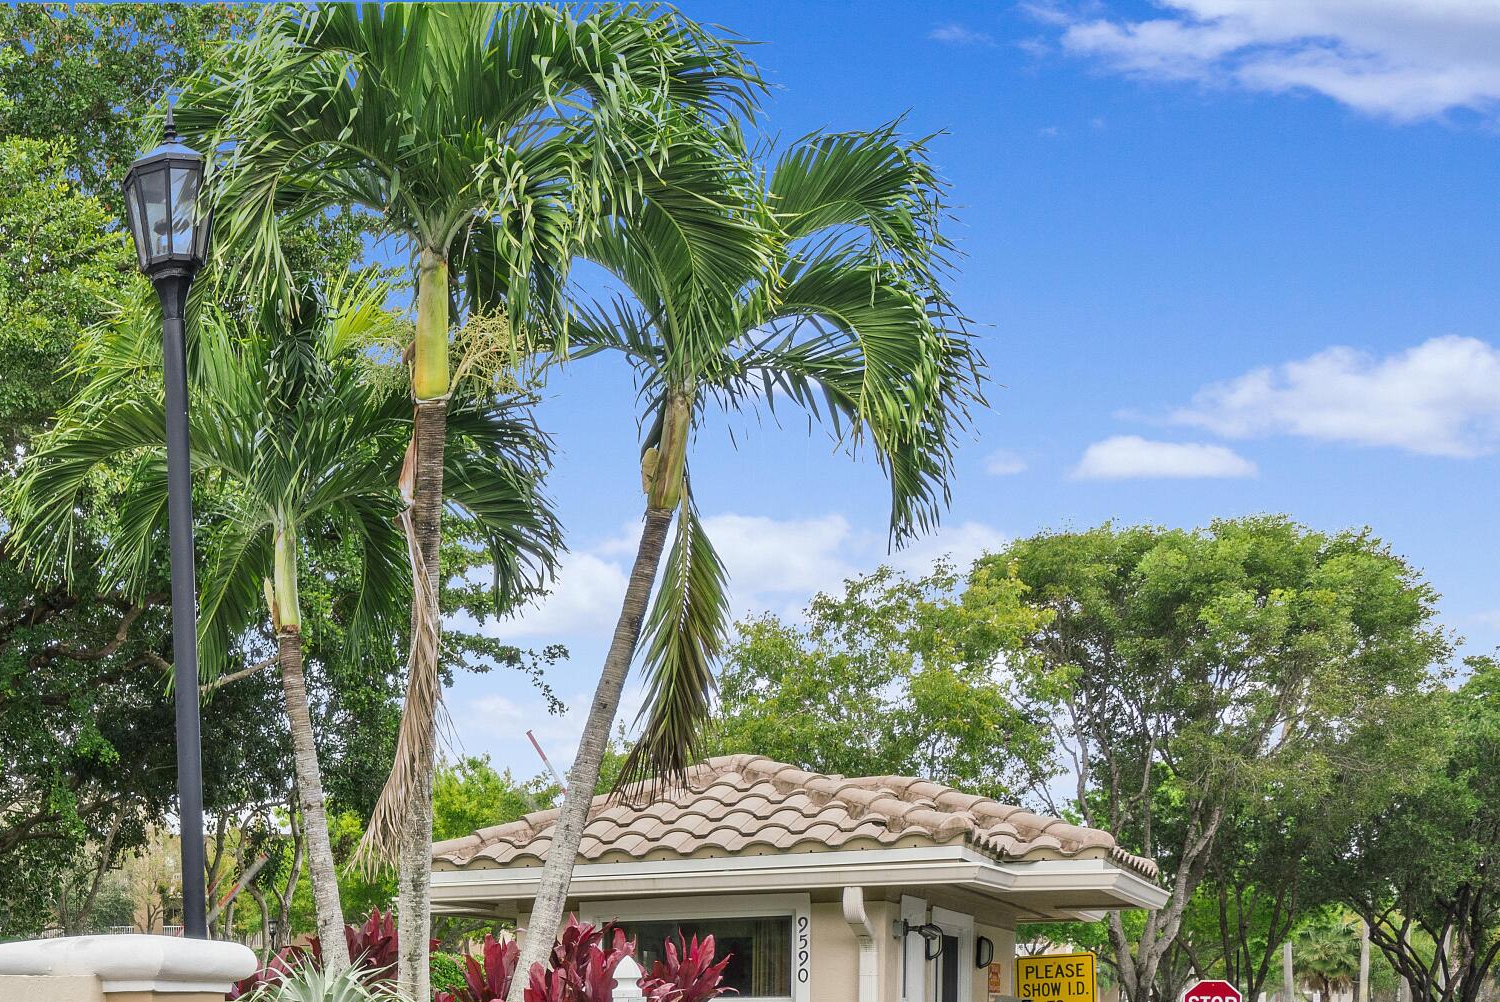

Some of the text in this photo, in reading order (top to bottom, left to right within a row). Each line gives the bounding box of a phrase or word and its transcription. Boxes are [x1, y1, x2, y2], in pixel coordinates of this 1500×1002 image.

[797, 916, 809, 984] 9590
[1025, 963, 1085, 980] PLEASE
[1023, 981, 1089, 997] SHOW I.D.
